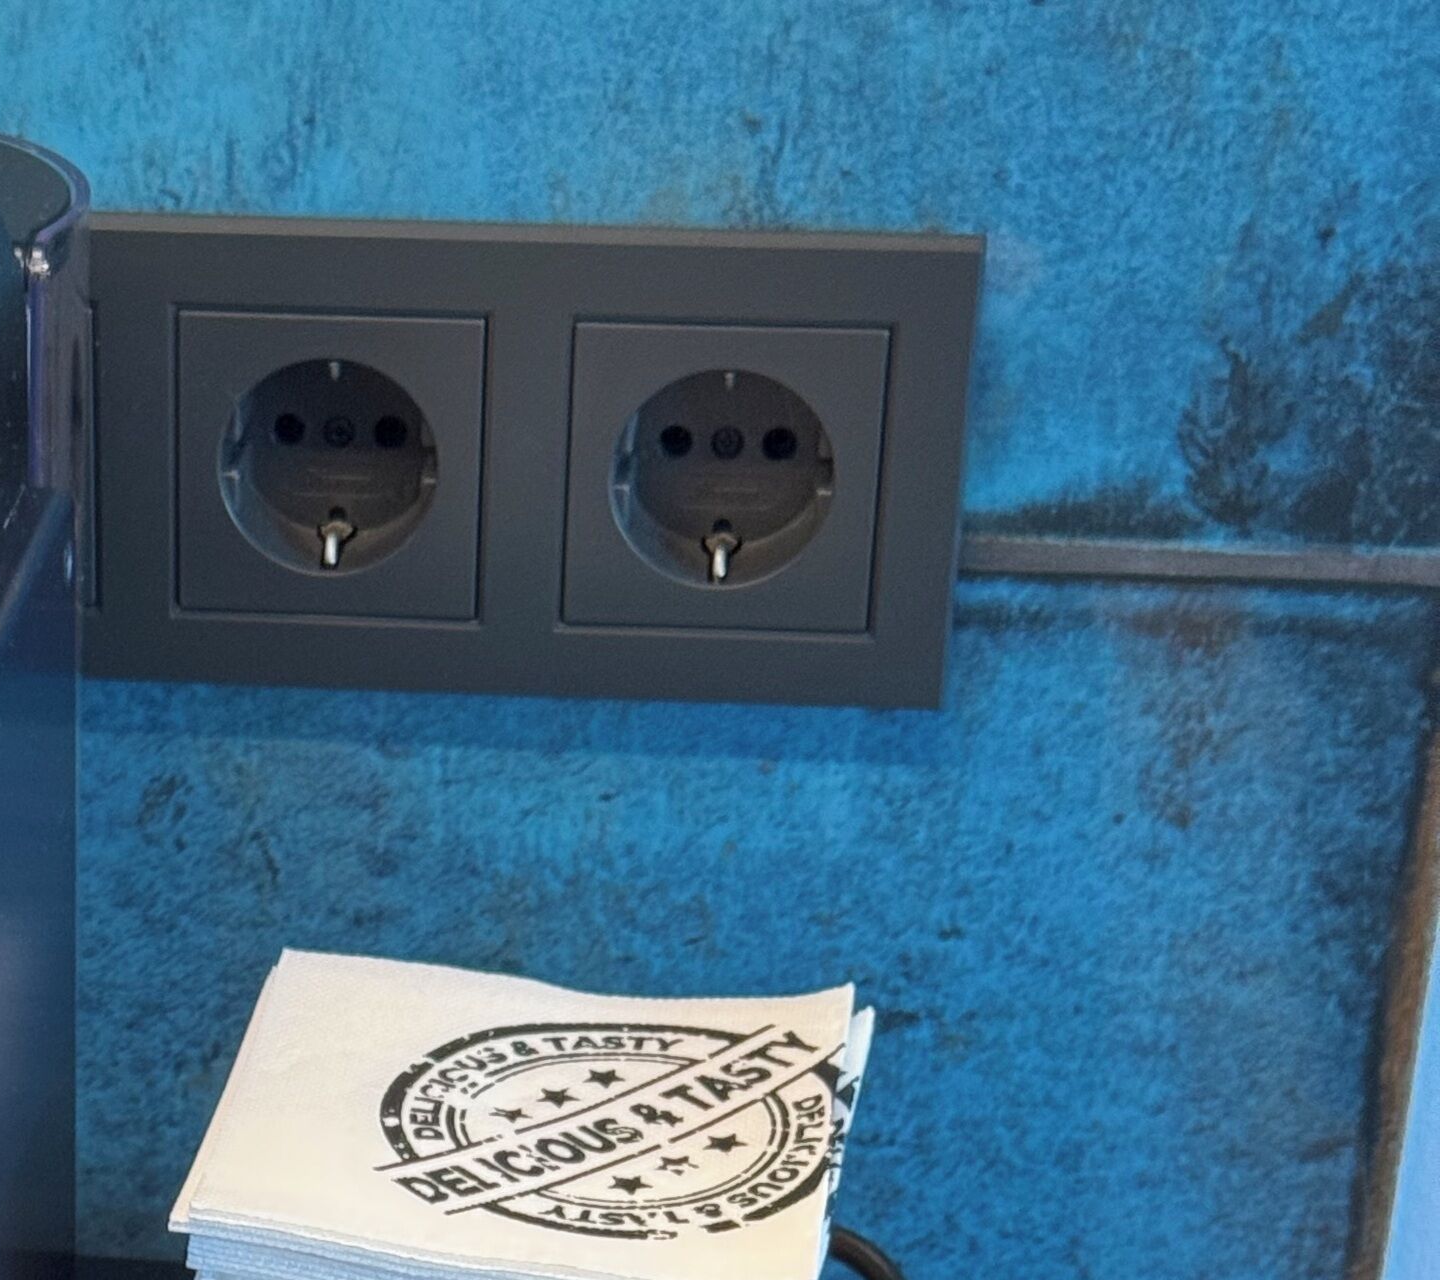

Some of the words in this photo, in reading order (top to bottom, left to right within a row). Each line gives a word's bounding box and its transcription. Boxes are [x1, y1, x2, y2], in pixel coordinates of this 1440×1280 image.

[543, 1035, 685, 1054] TASTY
[393, 1117, 645, 1204] DELICIOUS
[659, 1029, 821, 1112] TASTY
